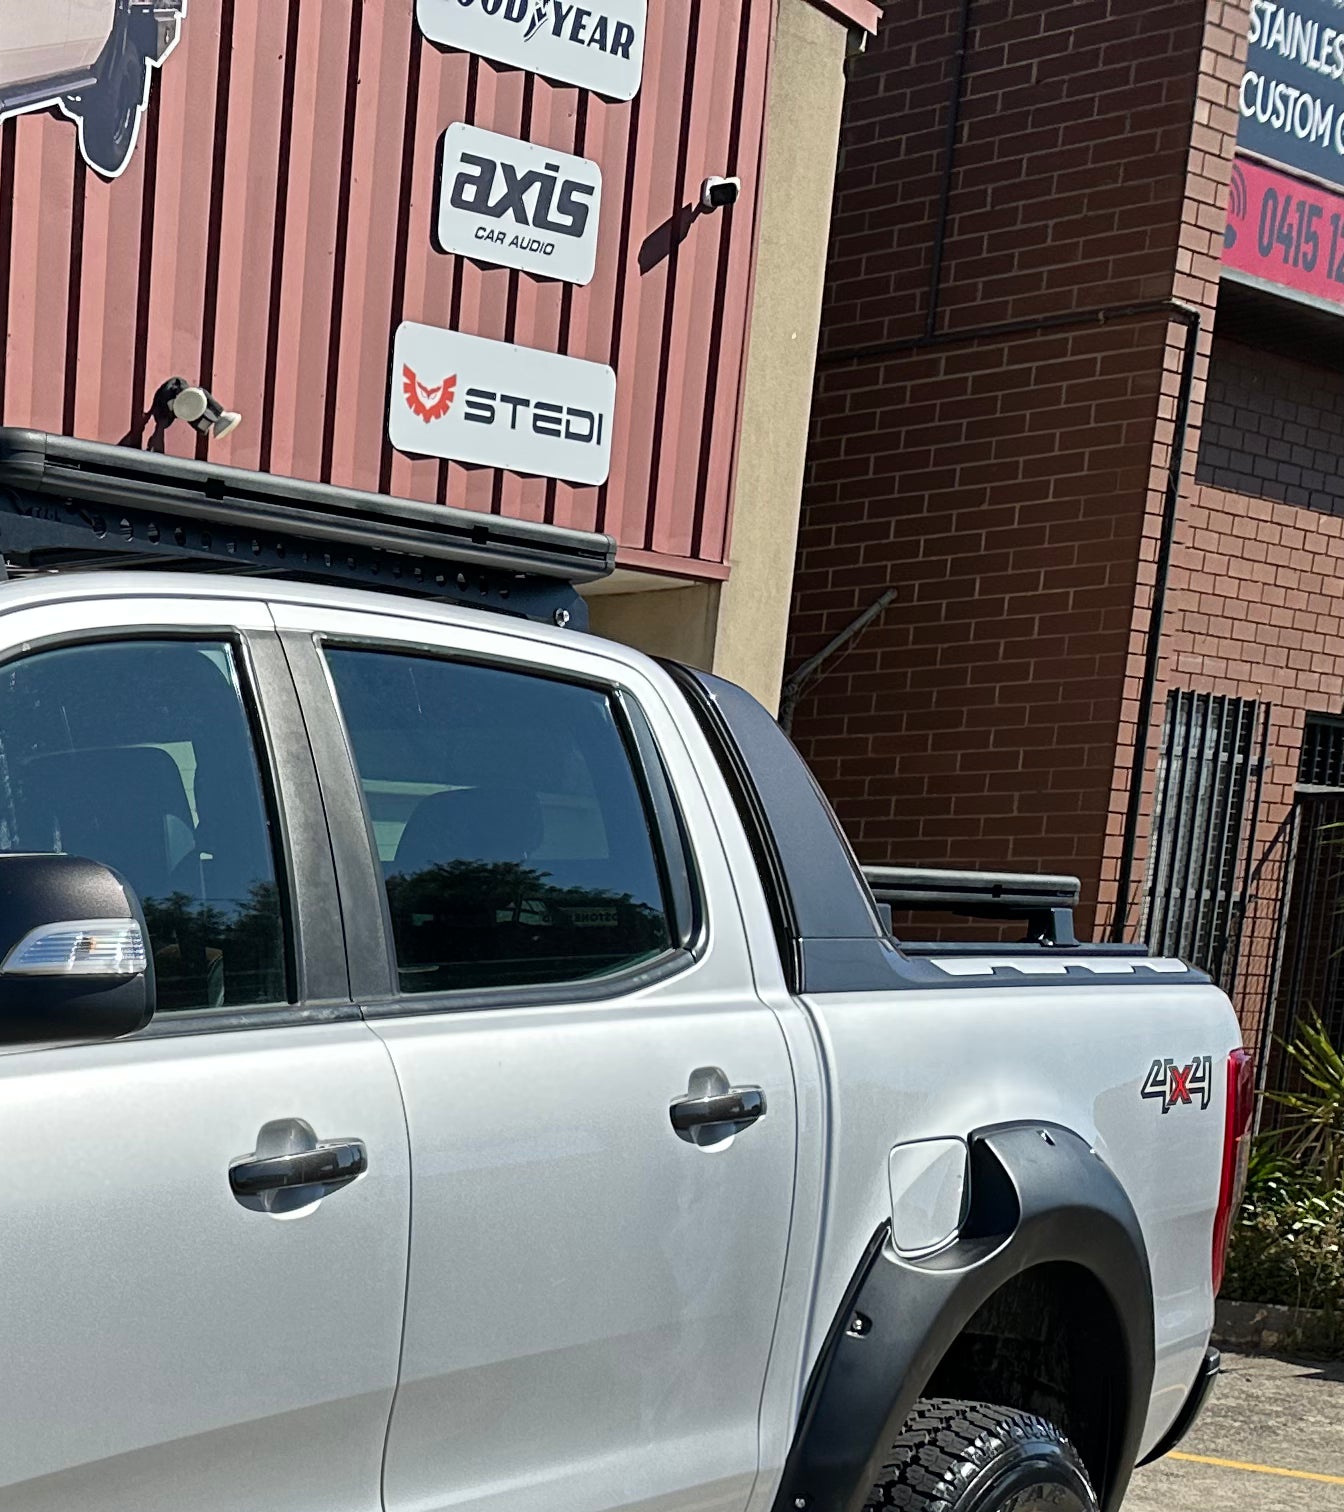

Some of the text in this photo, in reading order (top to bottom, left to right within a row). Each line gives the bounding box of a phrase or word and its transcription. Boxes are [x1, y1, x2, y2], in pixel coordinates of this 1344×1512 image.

[455, 0, 636, 60] DYEAR
[1246, 0, 1344, 81] STAINLES
[1238, 70, 1335, 147] CUSTOM
[449, 151, 595, 238] axis
[1257, 187, 1324, 273] 0415
[474, 226, 555, 257] CAR AUDIO
[463, 387, 603, 446] STEDI
